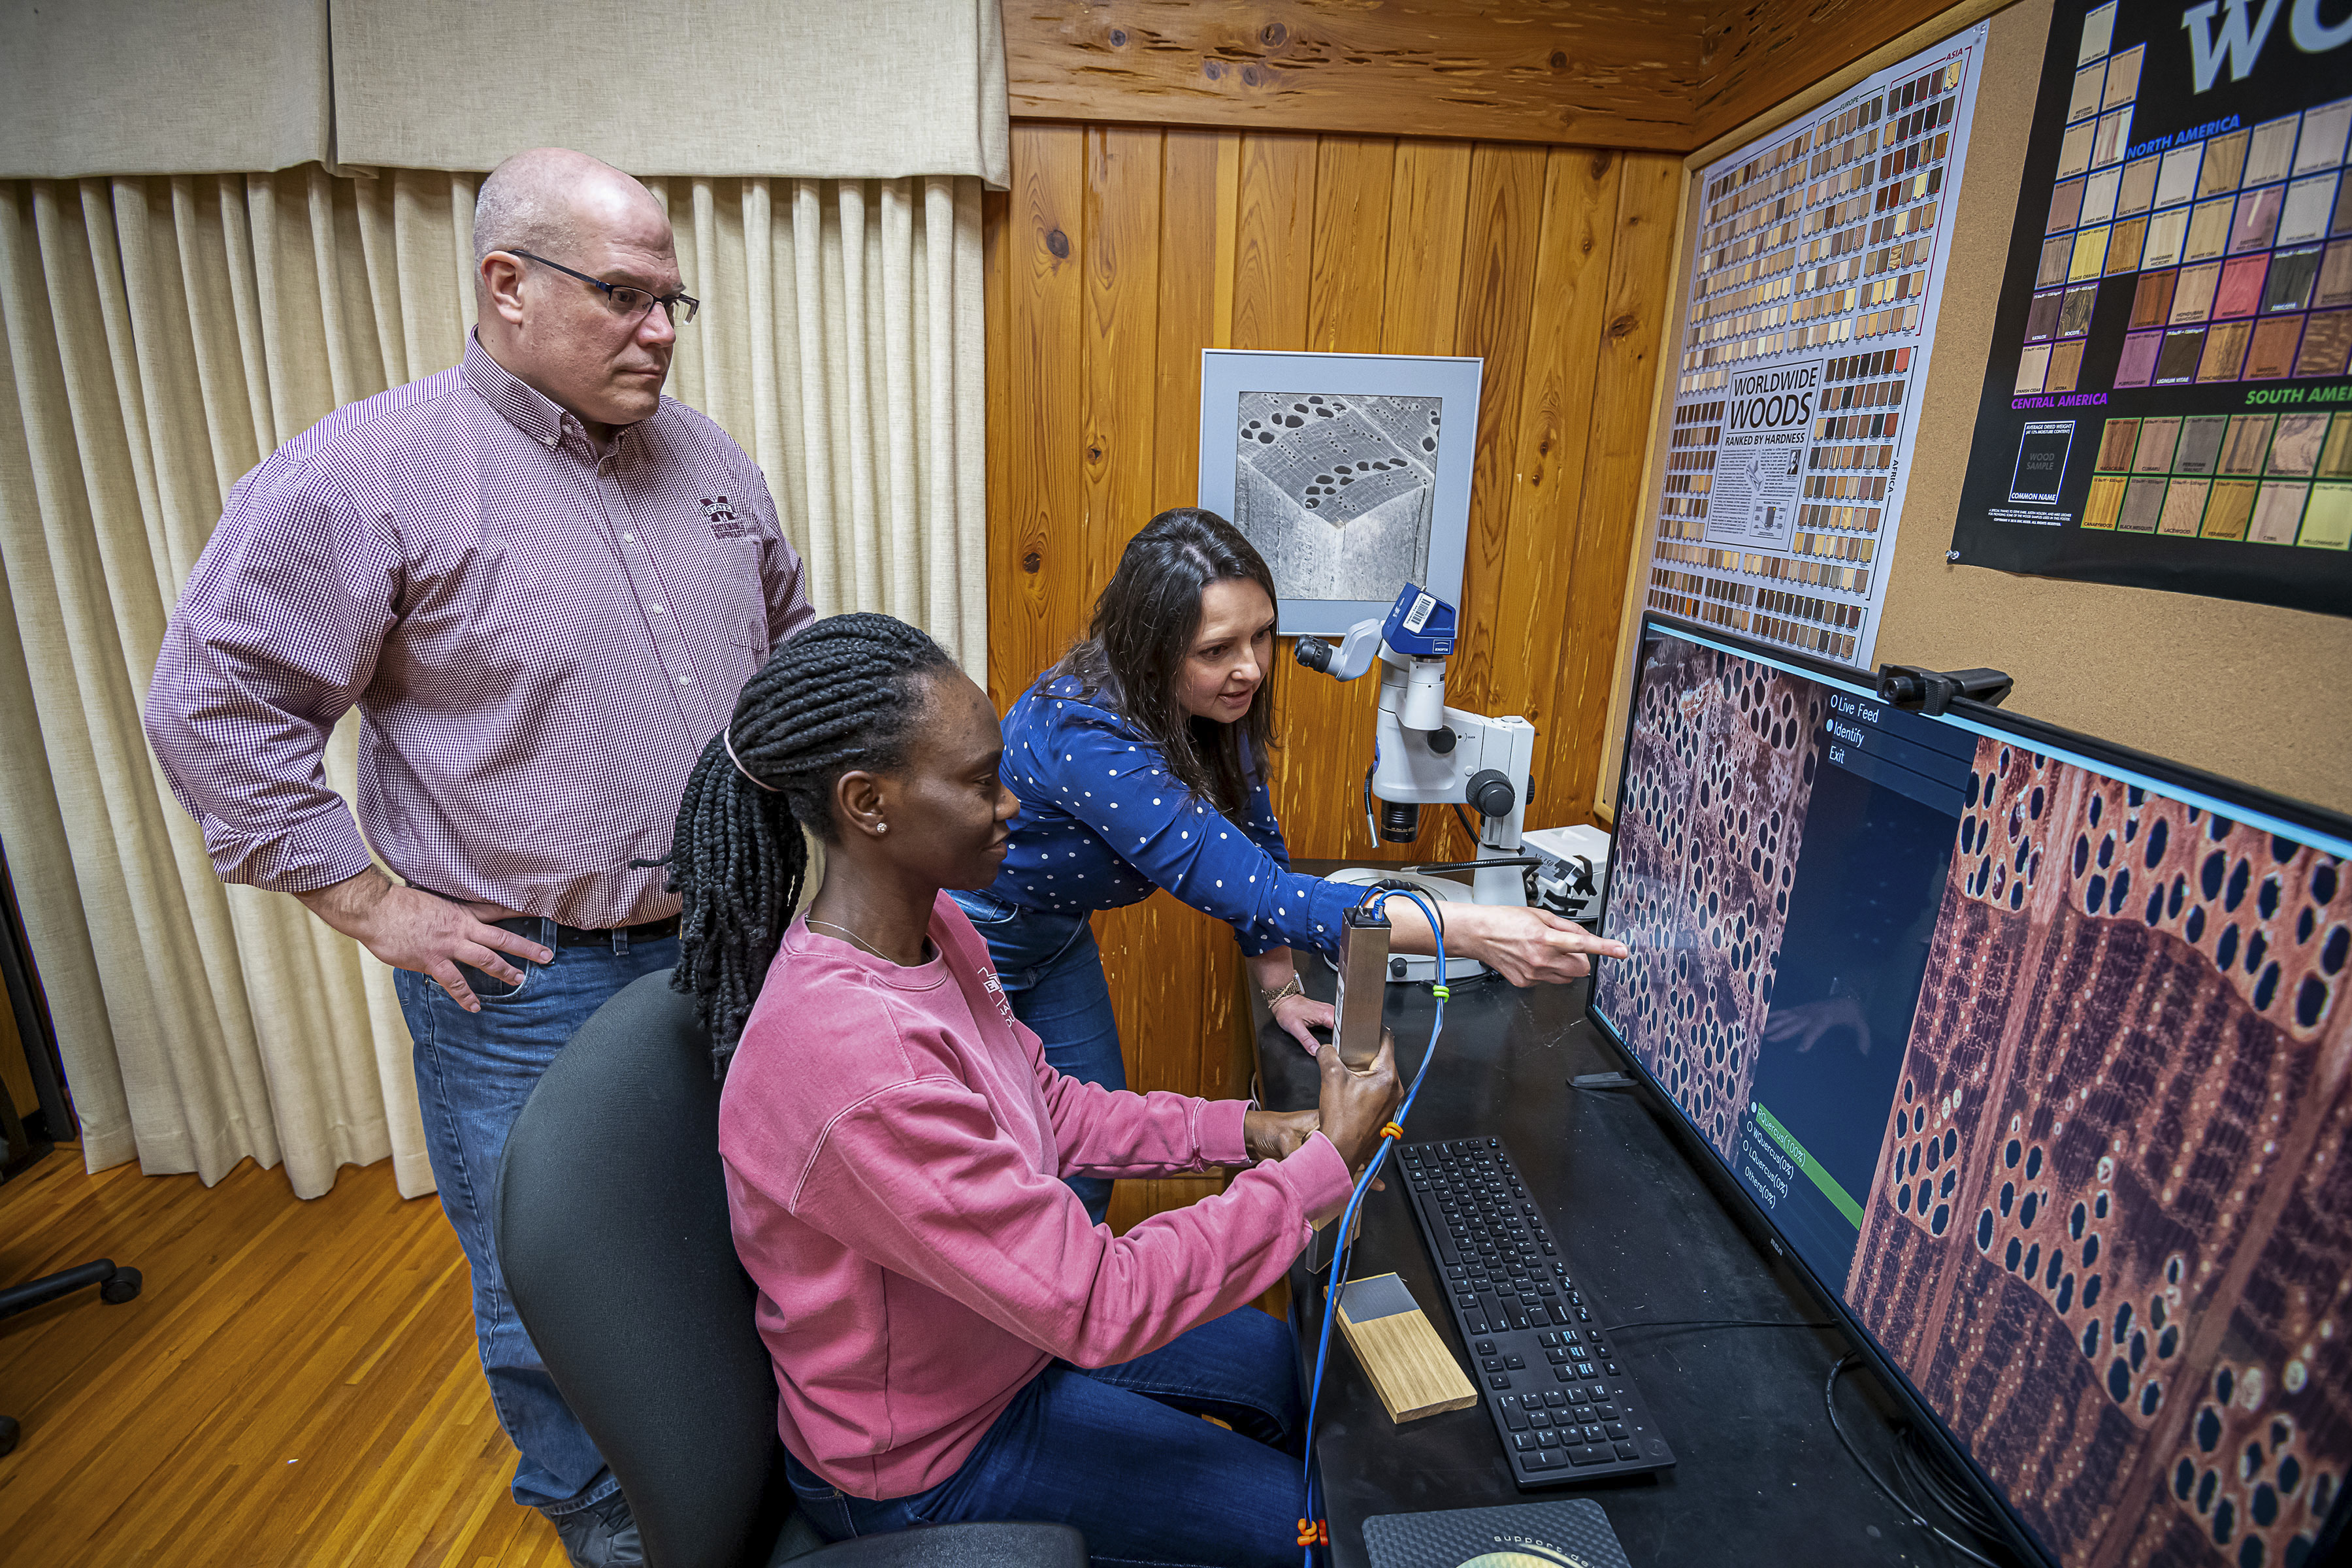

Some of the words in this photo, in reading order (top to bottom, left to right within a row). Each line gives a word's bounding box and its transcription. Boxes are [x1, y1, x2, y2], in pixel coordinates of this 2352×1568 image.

[1945, 48, 1963, 61] ASIA
[1839, 95, 1860, 111] EUROPE
[2126, 133, 2174, 160] NORTH
[2174, 113, 2241, 146] AMERICA
[1735, 367, 1819, 397] WORLDWIDE
[2011, 396, 2055, 410] CENTRAL
[2057, 392, 2108, 407] AMERICA
[2244, 387, 2306, 405] SOUTH
[2306, 385, 2352, 402] AME
[1731, 391, 1814, 430] WOODS
[1725, 435, 1754, 446] RANKED
[1754, 434, 1764, 445] BY
[1764, 432, 1806, 445] HARDNESS
[2026, 461, 2054, 470] SAMPLE
[2029, 453, 2055, 461] WOOD
[1887, 459, 1899, 493] AFRICA
[2011, 492, 2038, 500] COMMON
[706, 503, 730, 514] STATE
[1838, 696, 1855, 715] Live
[1857, 703, 1880, 723] Feed
[1834, 721, 1865, 748] Identify
[1829, 745, 1845, 764] Exit
[1757, 1108, 1806, 1168] RQuercus(100%)
[1753, 1127, 1794, 1180] WQuercus(0%)
[1748, 1147, 1788, 1198] LQuercus(0%)
[1744, 1166, 1776, 1209] Others(0%)
[1771, 1238, 1783, 1256] RCA
